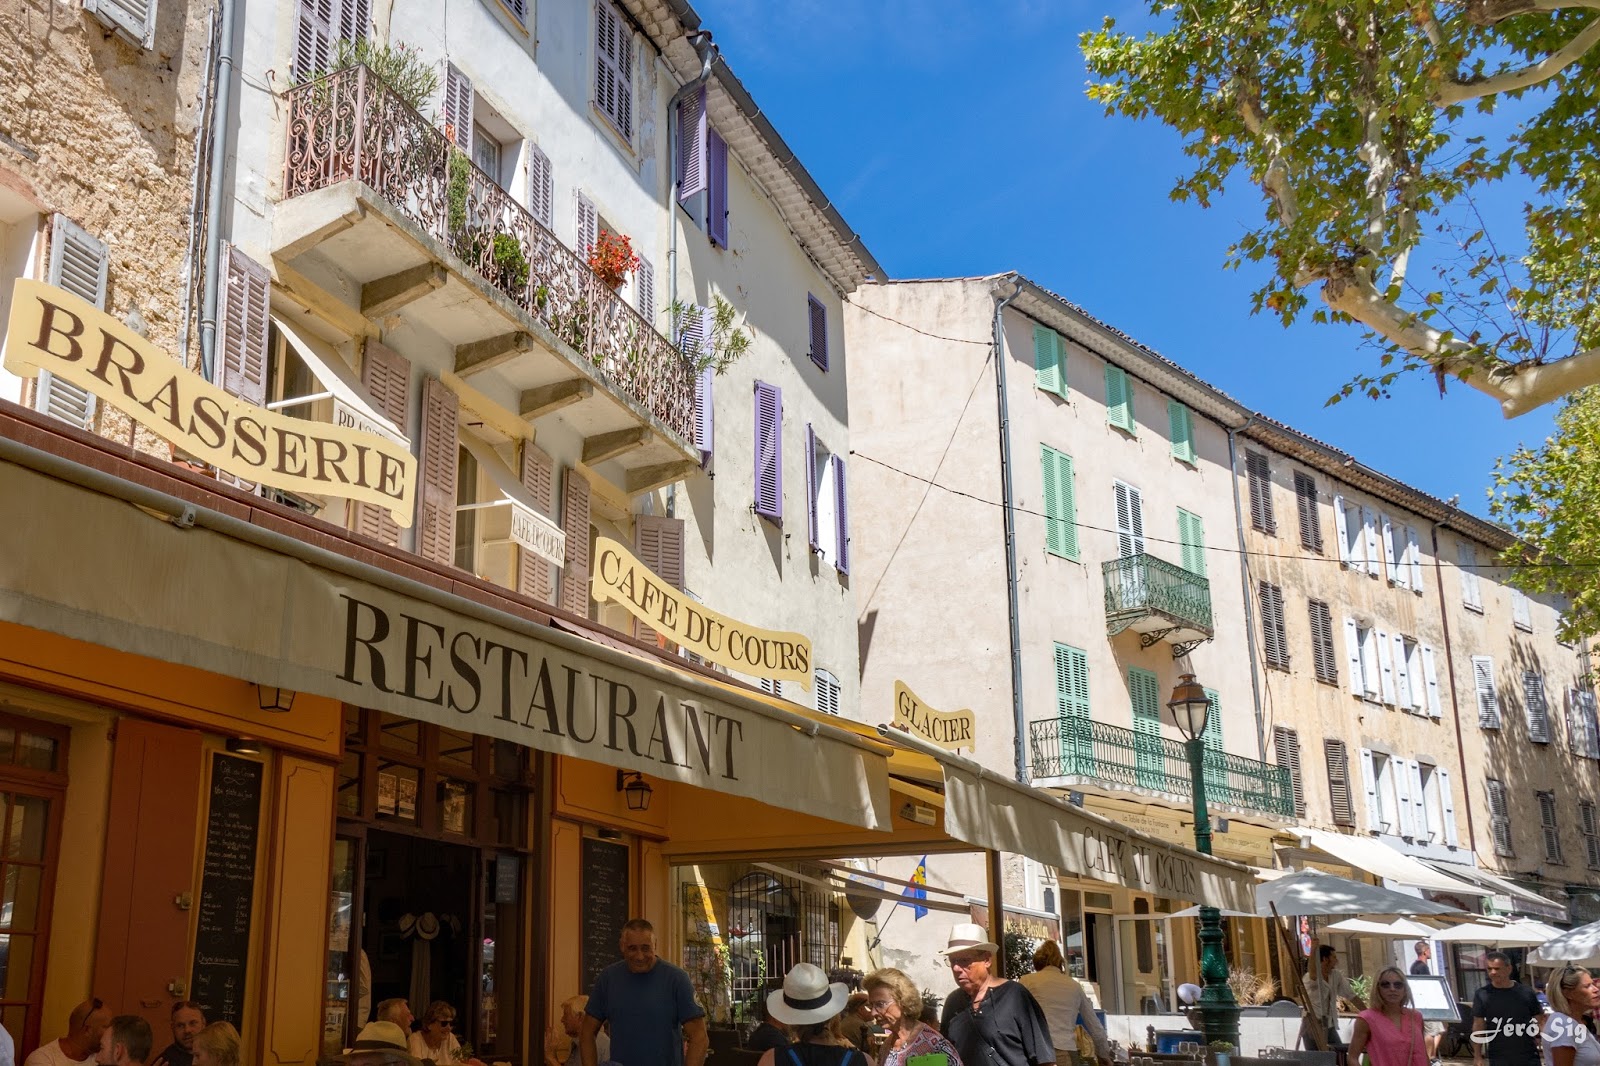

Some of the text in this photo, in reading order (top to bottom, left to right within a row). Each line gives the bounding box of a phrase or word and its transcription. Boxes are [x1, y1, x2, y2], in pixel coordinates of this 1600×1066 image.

[28, 296, 406, 501] BRASSERIE
[513, 513, 530, 542] CAFE
[600, 550, 808, 674] CAFE DU COURS
[336, 594, 743, 781] RESTAURANT
[899, 691, 971, 742] GLACIER
[1083, 827, 1196, 895] CAFE DU COURS
